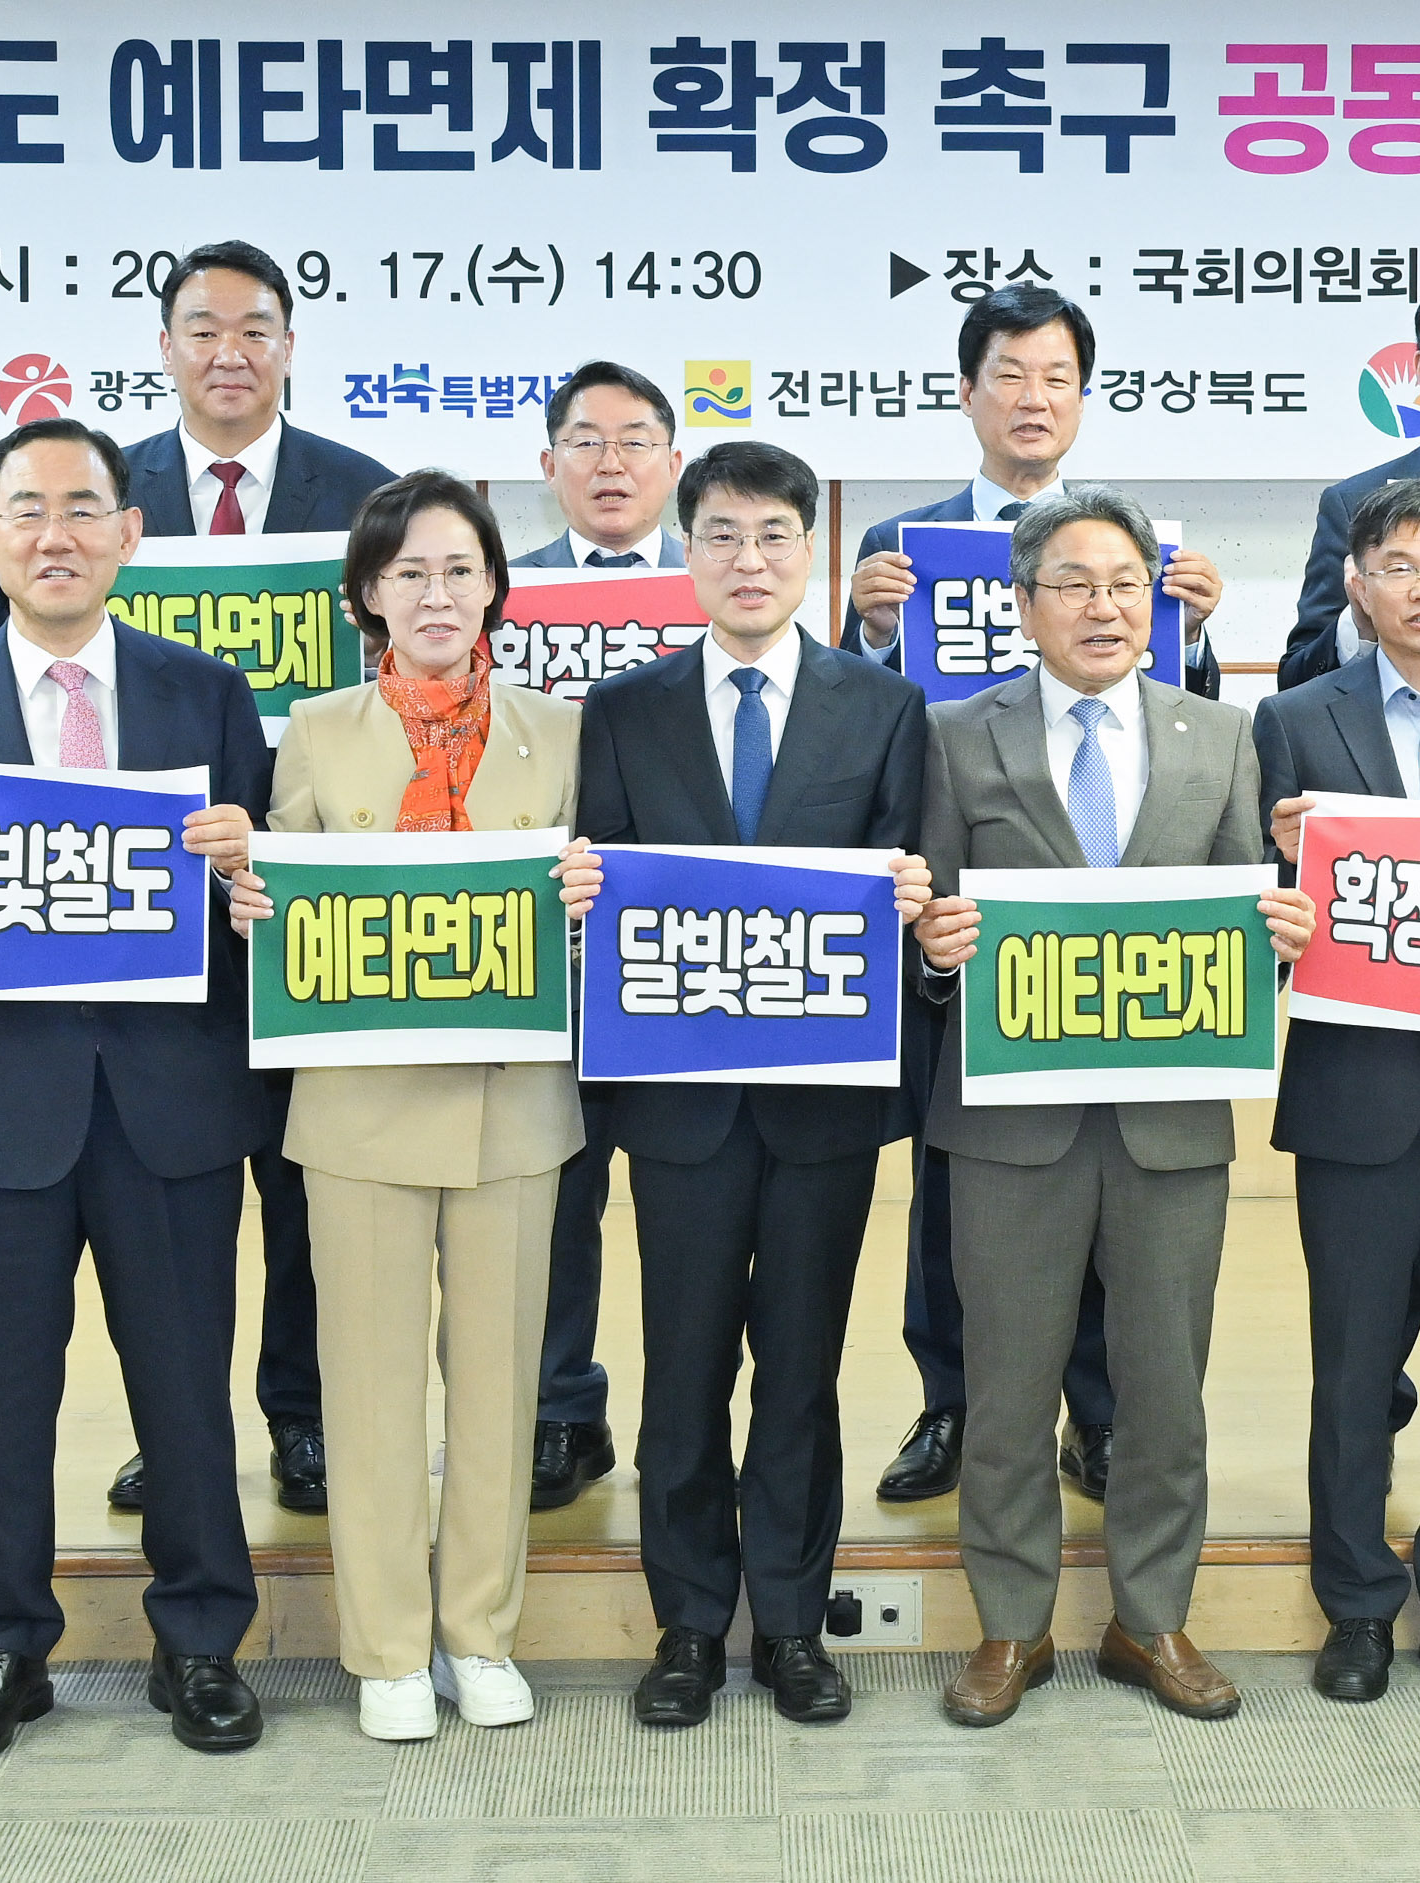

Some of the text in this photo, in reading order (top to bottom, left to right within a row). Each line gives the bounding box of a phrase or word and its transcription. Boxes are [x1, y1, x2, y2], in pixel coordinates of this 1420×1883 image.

[109, 39, 601, 171] 예타면제
[648, 36, 888, 174] 확정
[933, 36, 1175, 174] 촉구
[296, 250, 347, 302] 9.
[380, 245, 565, 305] 17.(수)
[596, 250, 762, 299] 14:30
[343, 363, 573, 418] 전북특별자
[768, 370, 961, 417] 전라남도
[1101, 370, 1308, 413] 경상북도
[282, 888, 537, 1004] 예타면제
[616, 905, 870, 1018] 달빛철도
[994, 927, 1248, 1044] 예타면제
